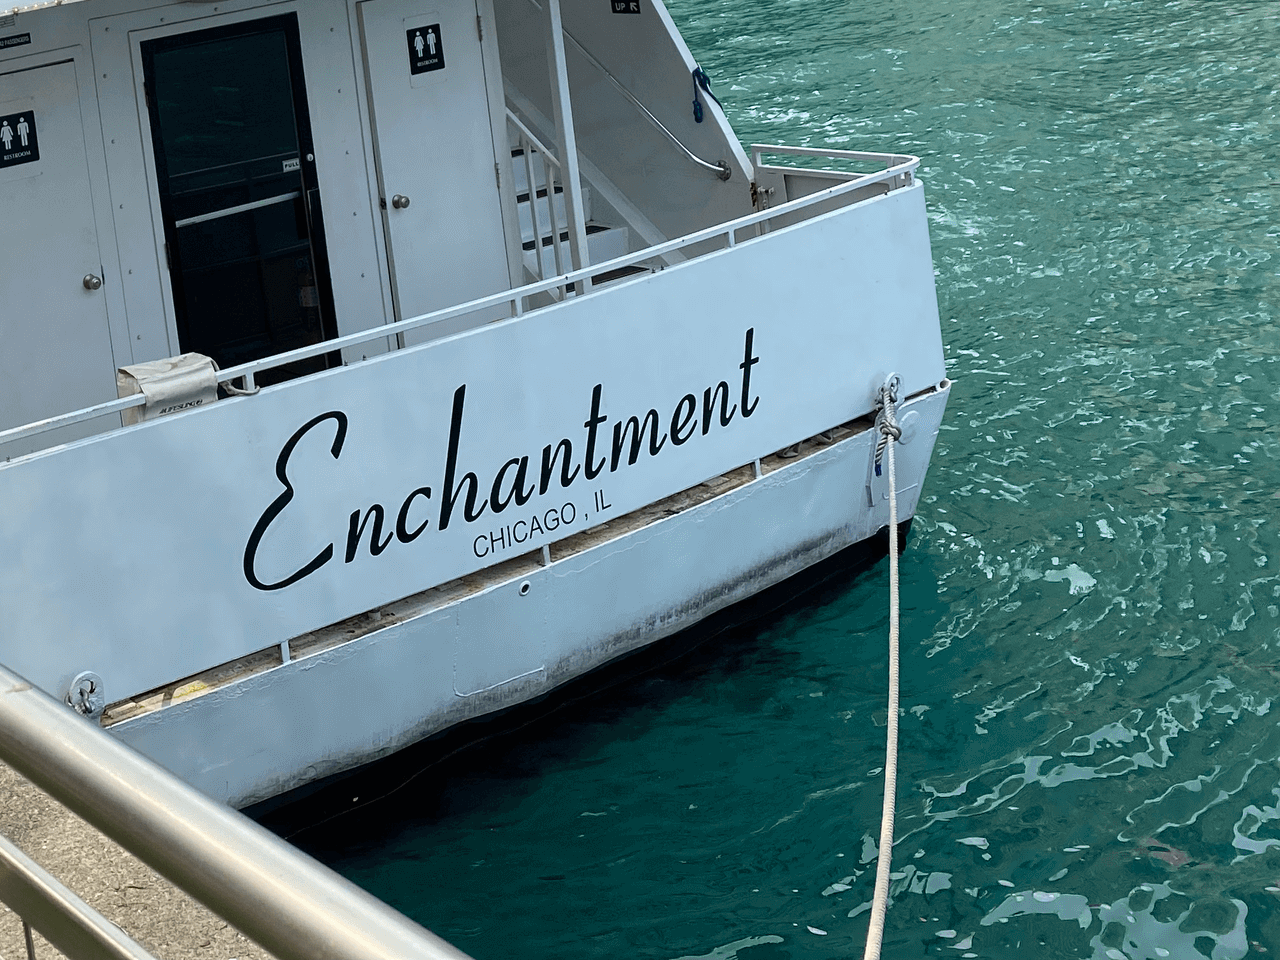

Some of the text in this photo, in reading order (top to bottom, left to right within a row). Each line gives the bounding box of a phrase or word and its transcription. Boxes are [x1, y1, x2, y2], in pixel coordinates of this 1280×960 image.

[615, 2, 626, 11] UP
[4, 35, 30, 46] PASSENGERS
[3, 150, 31, 161] RESTROOM
[284, 161, 299, 169] PULL
[243, 327, 761, 592] Enchantment
[473, 502, 576, 558] CHICAGO
[594, 489, 612, 513] IL
